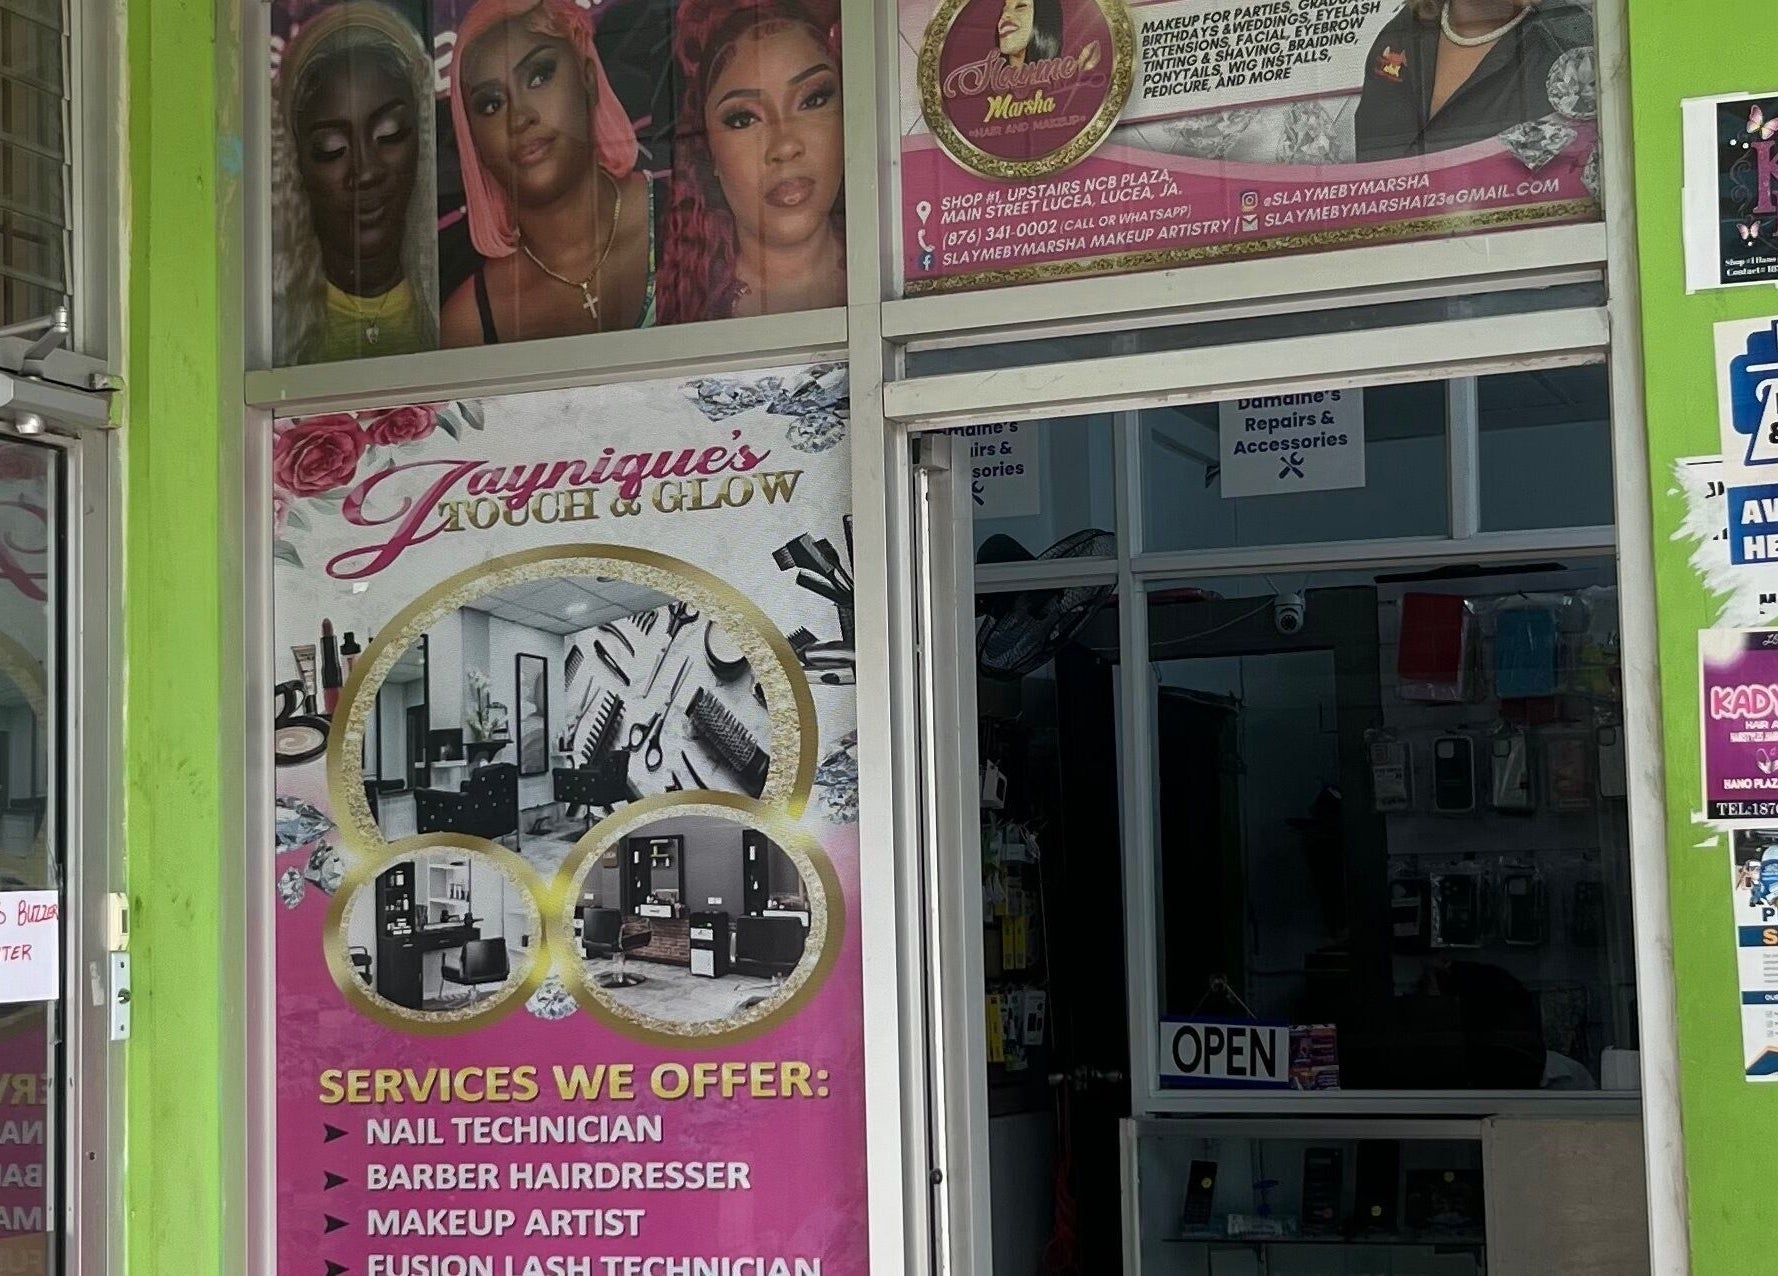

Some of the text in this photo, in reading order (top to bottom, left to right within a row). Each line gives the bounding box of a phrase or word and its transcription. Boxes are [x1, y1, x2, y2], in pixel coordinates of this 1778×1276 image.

[1141, 15, 1200, 34] MAKEUP
[1203, 10, 1231, 24] FOR
[1233, 1, 1294, 20] PARTIES,
[1142, 23, 1219, 47] BIRTHDAYS
[1315, 1, 1381, 22] EYELASH
[1142, 17, 1365, 60] EXTENSIONS, FACIAL, EYEBROW
[1143, 32, 1359, 73] TINTING & SHAVING, BRAIDING,
[1143, 49, 1332, 86] PONYTAILS, WIG INSTALLS,
[1143, 67, 1292, 99] PEDICURE, AND MORE
[983, 89, 1056, 123] Marsha
[940, 192, 983, 211] SHOP
[1006, 180, 1080, 202] UPSTAIRS
[1084, 177, 1117, 191] NCB
[1120, 169, 1174, 188] PLAZA,
[940, 182, 1183, 225] MAIN STREET LUCEA, LUCEA, JA.
[941, 227, 983, 250] (876)
[985, 219, 1058, 242] 341-0002
[1059, 216, 1096, 235] (CALL
[1098, 214, 1117, 228] OR
[941, 218, 1231, 266] SLAYMEBYMARSHA MAKEUP ARTISTRY
[1244, 410, 1335, 434] Repairs &
[999, 441, 1012, 455] &
[1233, 431, 1348, 456] Accessories
[325, 430, 771, 580] Jaynique's
[438, 470, 804, 532] TOUCH & GLOW
[1716, 802, 1778, 816] TEL:187
[0, 944, 32, 961] TER
[1172, 1025, 1276, 1078] OPEN
[319, 1060, 831, 1104] SERVICES WE OFFER:
[366, 1114, 664, 1145] NAIL TECHNICIAN
[366, 1160, 752, 1191] BARBER HAIRDRESSER
[366, 1208, 646, 1237] MAKEUP ARTIST
[366, 1254, 822, 1276] FUSION LASH TECHNICIAN
